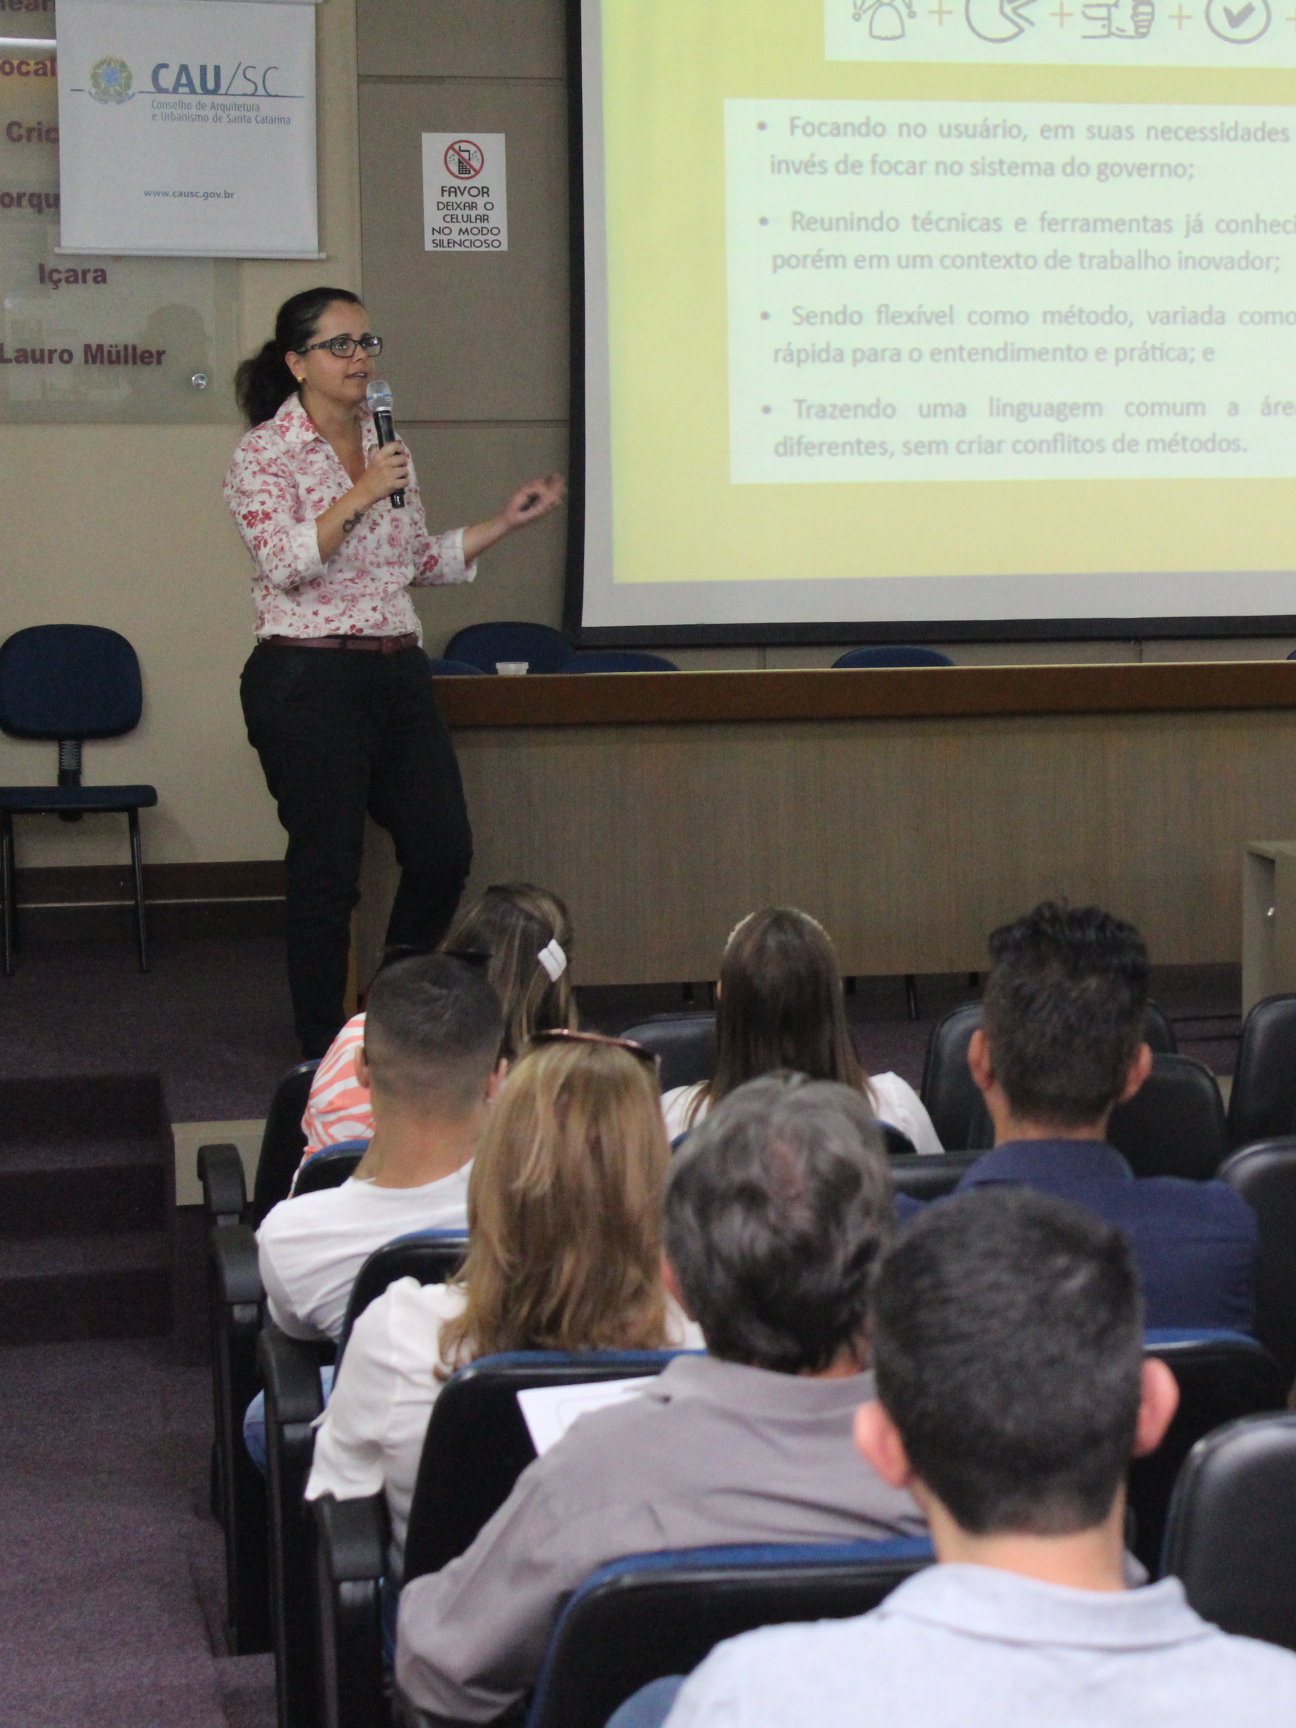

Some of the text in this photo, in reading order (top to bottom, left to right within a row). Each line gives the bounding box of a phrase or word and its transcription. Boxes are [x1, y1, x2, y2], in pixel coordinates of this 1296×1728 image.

[151, 61, 279, 97] CAU/SC
[151, 99, 261, 113] Conselho de Arquitetura
[151, 112, 291, 125] e Urbanismo de Santa Catarina
[788, 114, 888, 139] Focando
[897, 121, 928, 139] no
[937, 116, 1029, 143] usuário,
[1039, 123, 1076, 141] em
[1085, 123, 1136, 142] suas
[1145, 119, 1291, 144] necessidades
[769, 151, 1195, 184] invés de focar no sistema do governo;
[143, 189, 235, 200] www.causc.gov.br
[440, 185, 490, 198] FAVOR
[436, 201, 495, 211] DEIXAR O
[442, 213, 490, 224] CELULAR
[431, 226, 501, 236] NO MODO
[790, 209, 901, 233] Reunindo
[910, 209, 1004, 234] técnicas
[1013, 216, 1028, 234] e
[1038, 209, 1174, 234] ferramentas
[1183, 211, 1205, 239] já
[431, 238, 502, 249] SILENCIOSO
[771, 247, 1281, 275] porém em um contexto de trabalho inovador;
[38, 262, 108, 290] Içara
[791, 303, 864, 327] Sendo
[874, 302, 955, 327] flexível
[966, 309, 1031, 326] como
[1041, 303, 1135, 329] método,
[1146, 303, 1227, 326] variada
[0, 342, 167, 366] Lauro Müller
[773, 339, 1216, 369] rápida para o entendimento e prática; e
[792, 396, 898, 421] Trazendo
[917, 401, 968, 419] uma
[988, 395, 1104, 424] linguagem
[1124, 400, 1207, 418] comum
[1226, 400, 1240, 418] a
[773, 430, 1248, 460] diferentes, sem criar conflitos de métodos.
